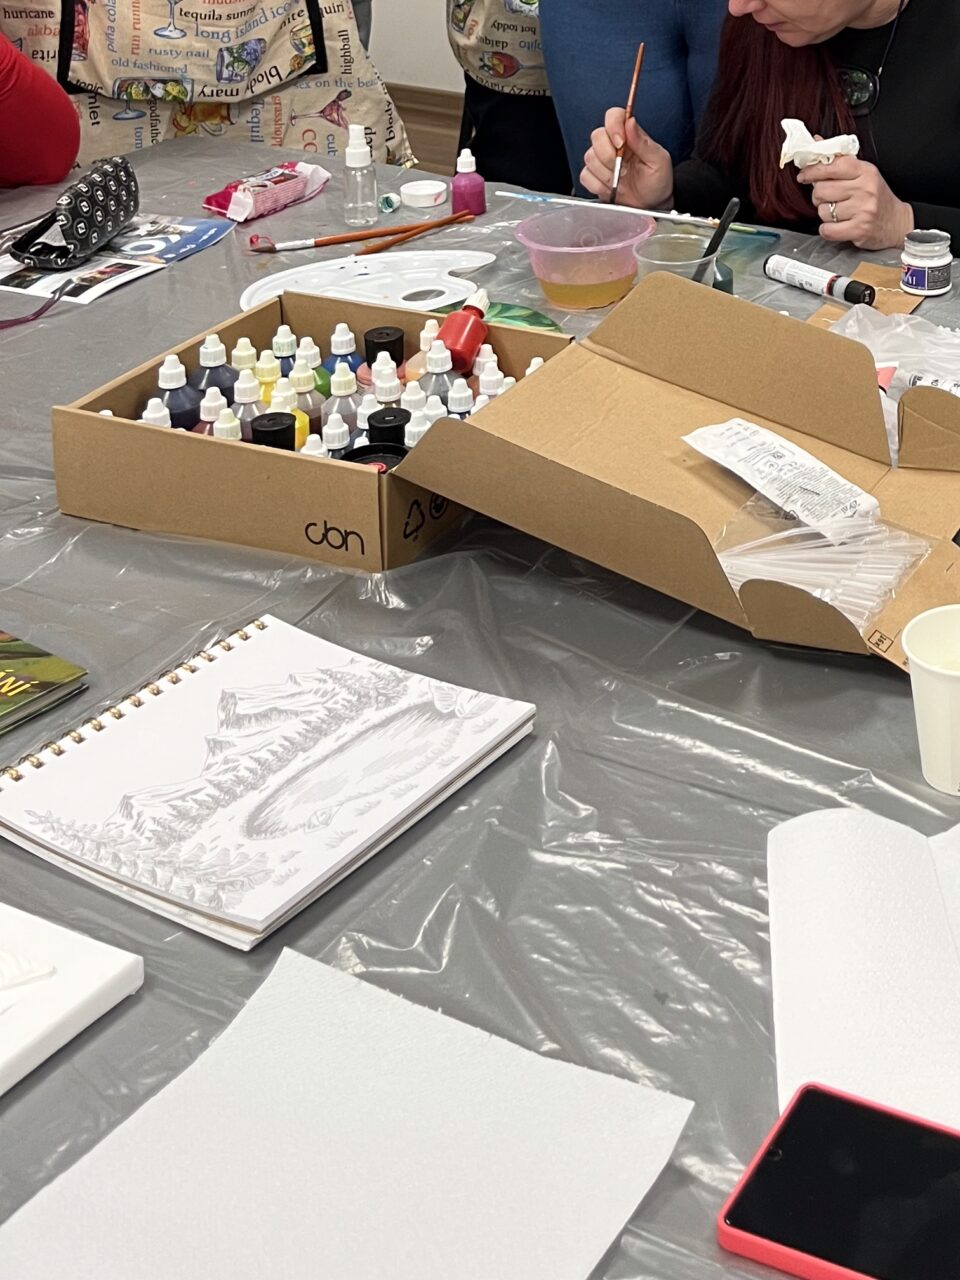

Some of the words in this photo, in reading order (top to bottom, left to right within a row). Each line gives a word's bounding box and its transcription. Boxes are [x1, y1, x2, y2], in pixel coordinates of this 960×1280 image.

[3, 8, 55, 20] huricane
[179, 7, 222, 24] tequila
[195, 22, 231, 43] long
[491, 19, 518, 33] toddy
[149, 48, 182, 60] rusty
[186, 48, 210, 59] nail
[338, 29, 354, 75] highball
[111, 58, 129, 68] old
[133, 58, 187, 74] fashioned
[315, 80, 331, 89] on
[335, 78, 354, 89] the
[198, 85, 239, 99] mary
